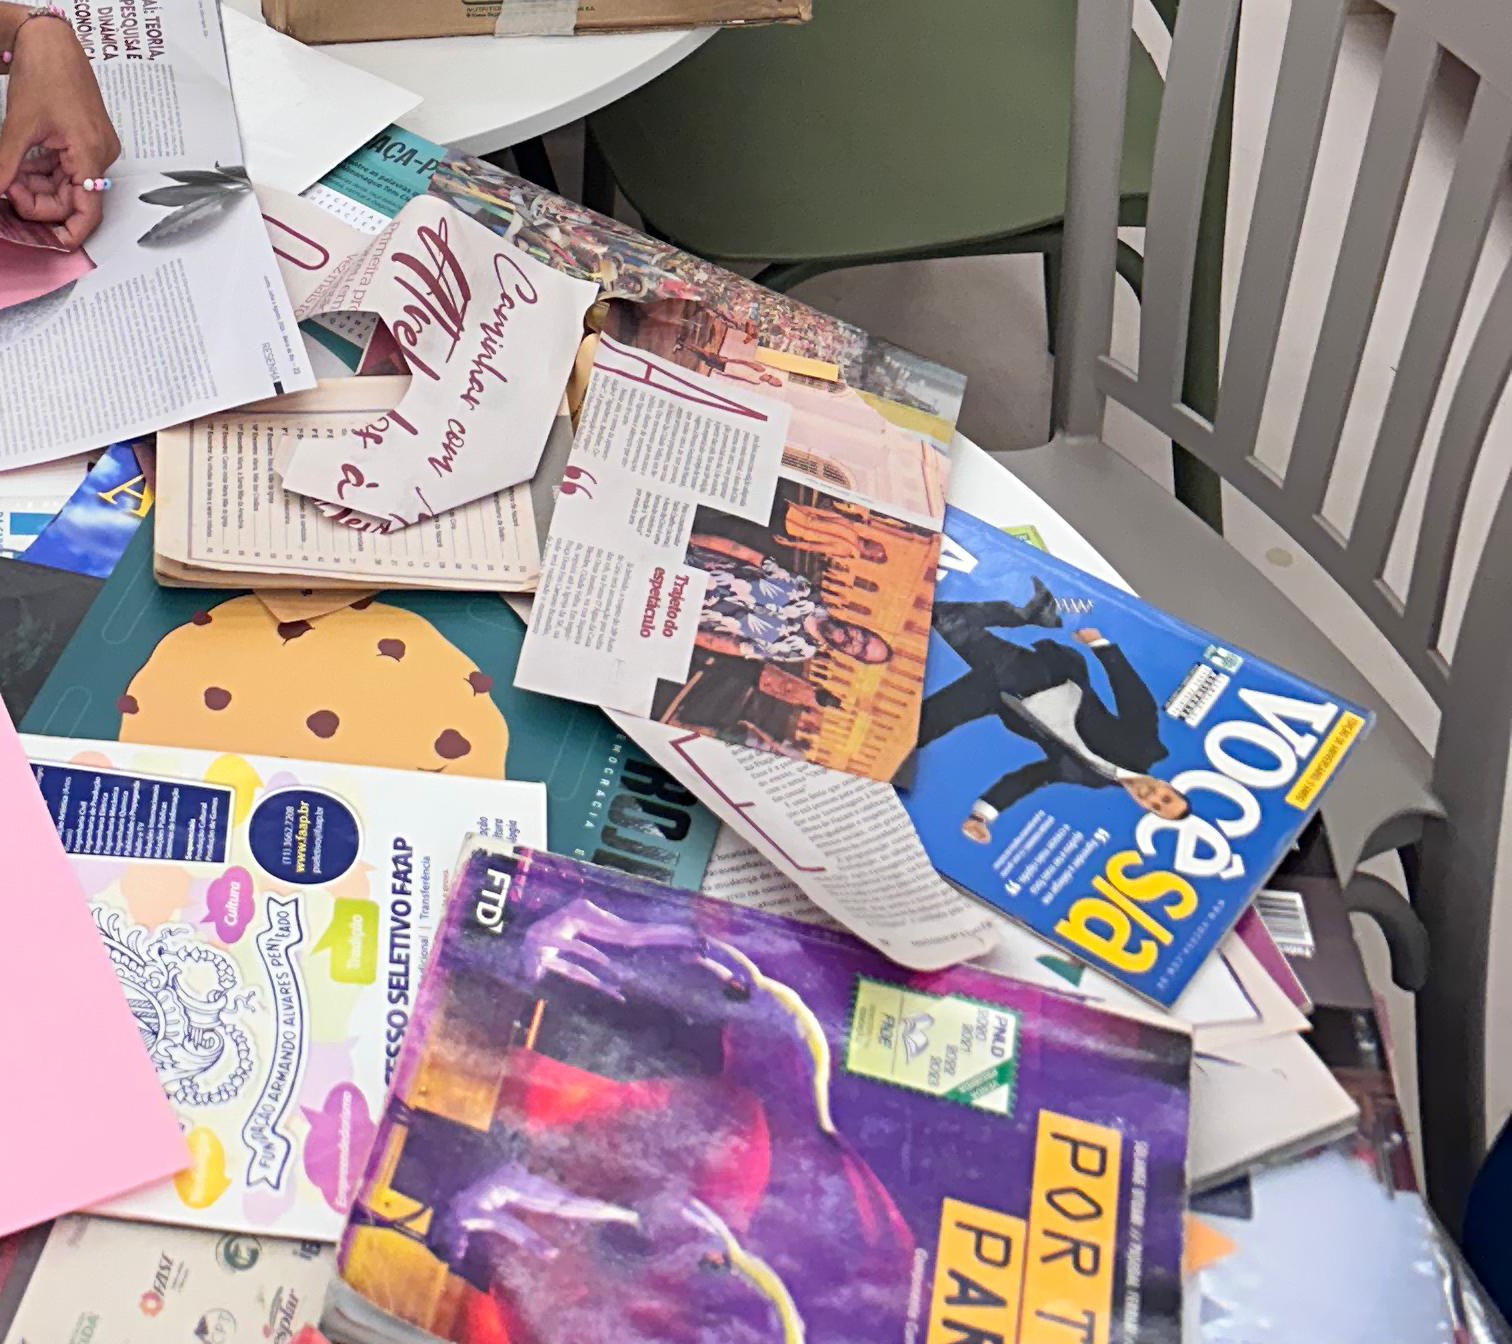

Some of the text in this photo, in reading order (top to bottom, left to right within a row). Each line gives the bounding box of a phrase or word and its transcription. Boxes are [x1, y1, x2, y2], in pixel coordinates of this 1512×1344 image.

[97, 6, 121, 60] DINÂMICA
[143, 16, 164, 61] TEORIA,
[261, 343, 280, 381] RESENHA
[639, 565, 667, 640] espetáculo
[584, 733, 627, 829] EMOCRACIA
[293, 800, 311, 873] www.faap.br
[224, 879, 242, 928] Cultura
[419, 855, 432, 920] Transferência
[475, 868, 512, 935] FTD
[268, 908, 290, 969] PENTEADO
[385, 836, 414, 1091] ESSO SELETIVO FAAP
[283, 970, 298, 1029] ALVARES
[273, 1030, 298, 1103] ARMANDO
[990, 1013, 1007, 1059] PNLD
[1046, 1130, 1103, 1279] POR
